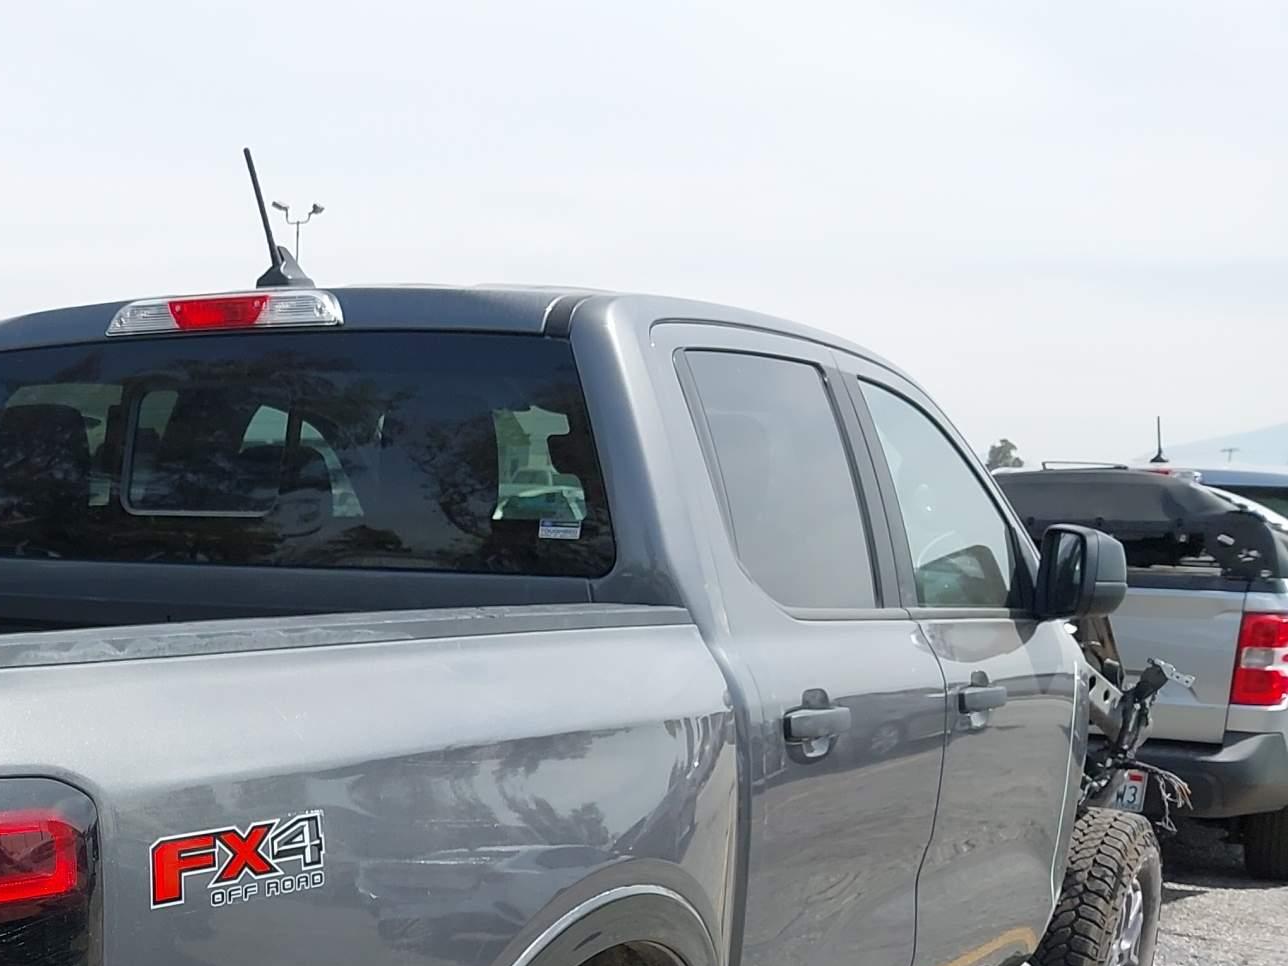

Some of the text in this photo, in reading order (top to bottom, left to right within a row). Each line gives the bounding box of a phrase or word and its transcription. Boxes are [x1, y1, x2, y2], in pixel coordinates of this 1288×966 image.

[149, 812, 325, 910] FX4
[211, 870, 325, 907] OFF ROAD
